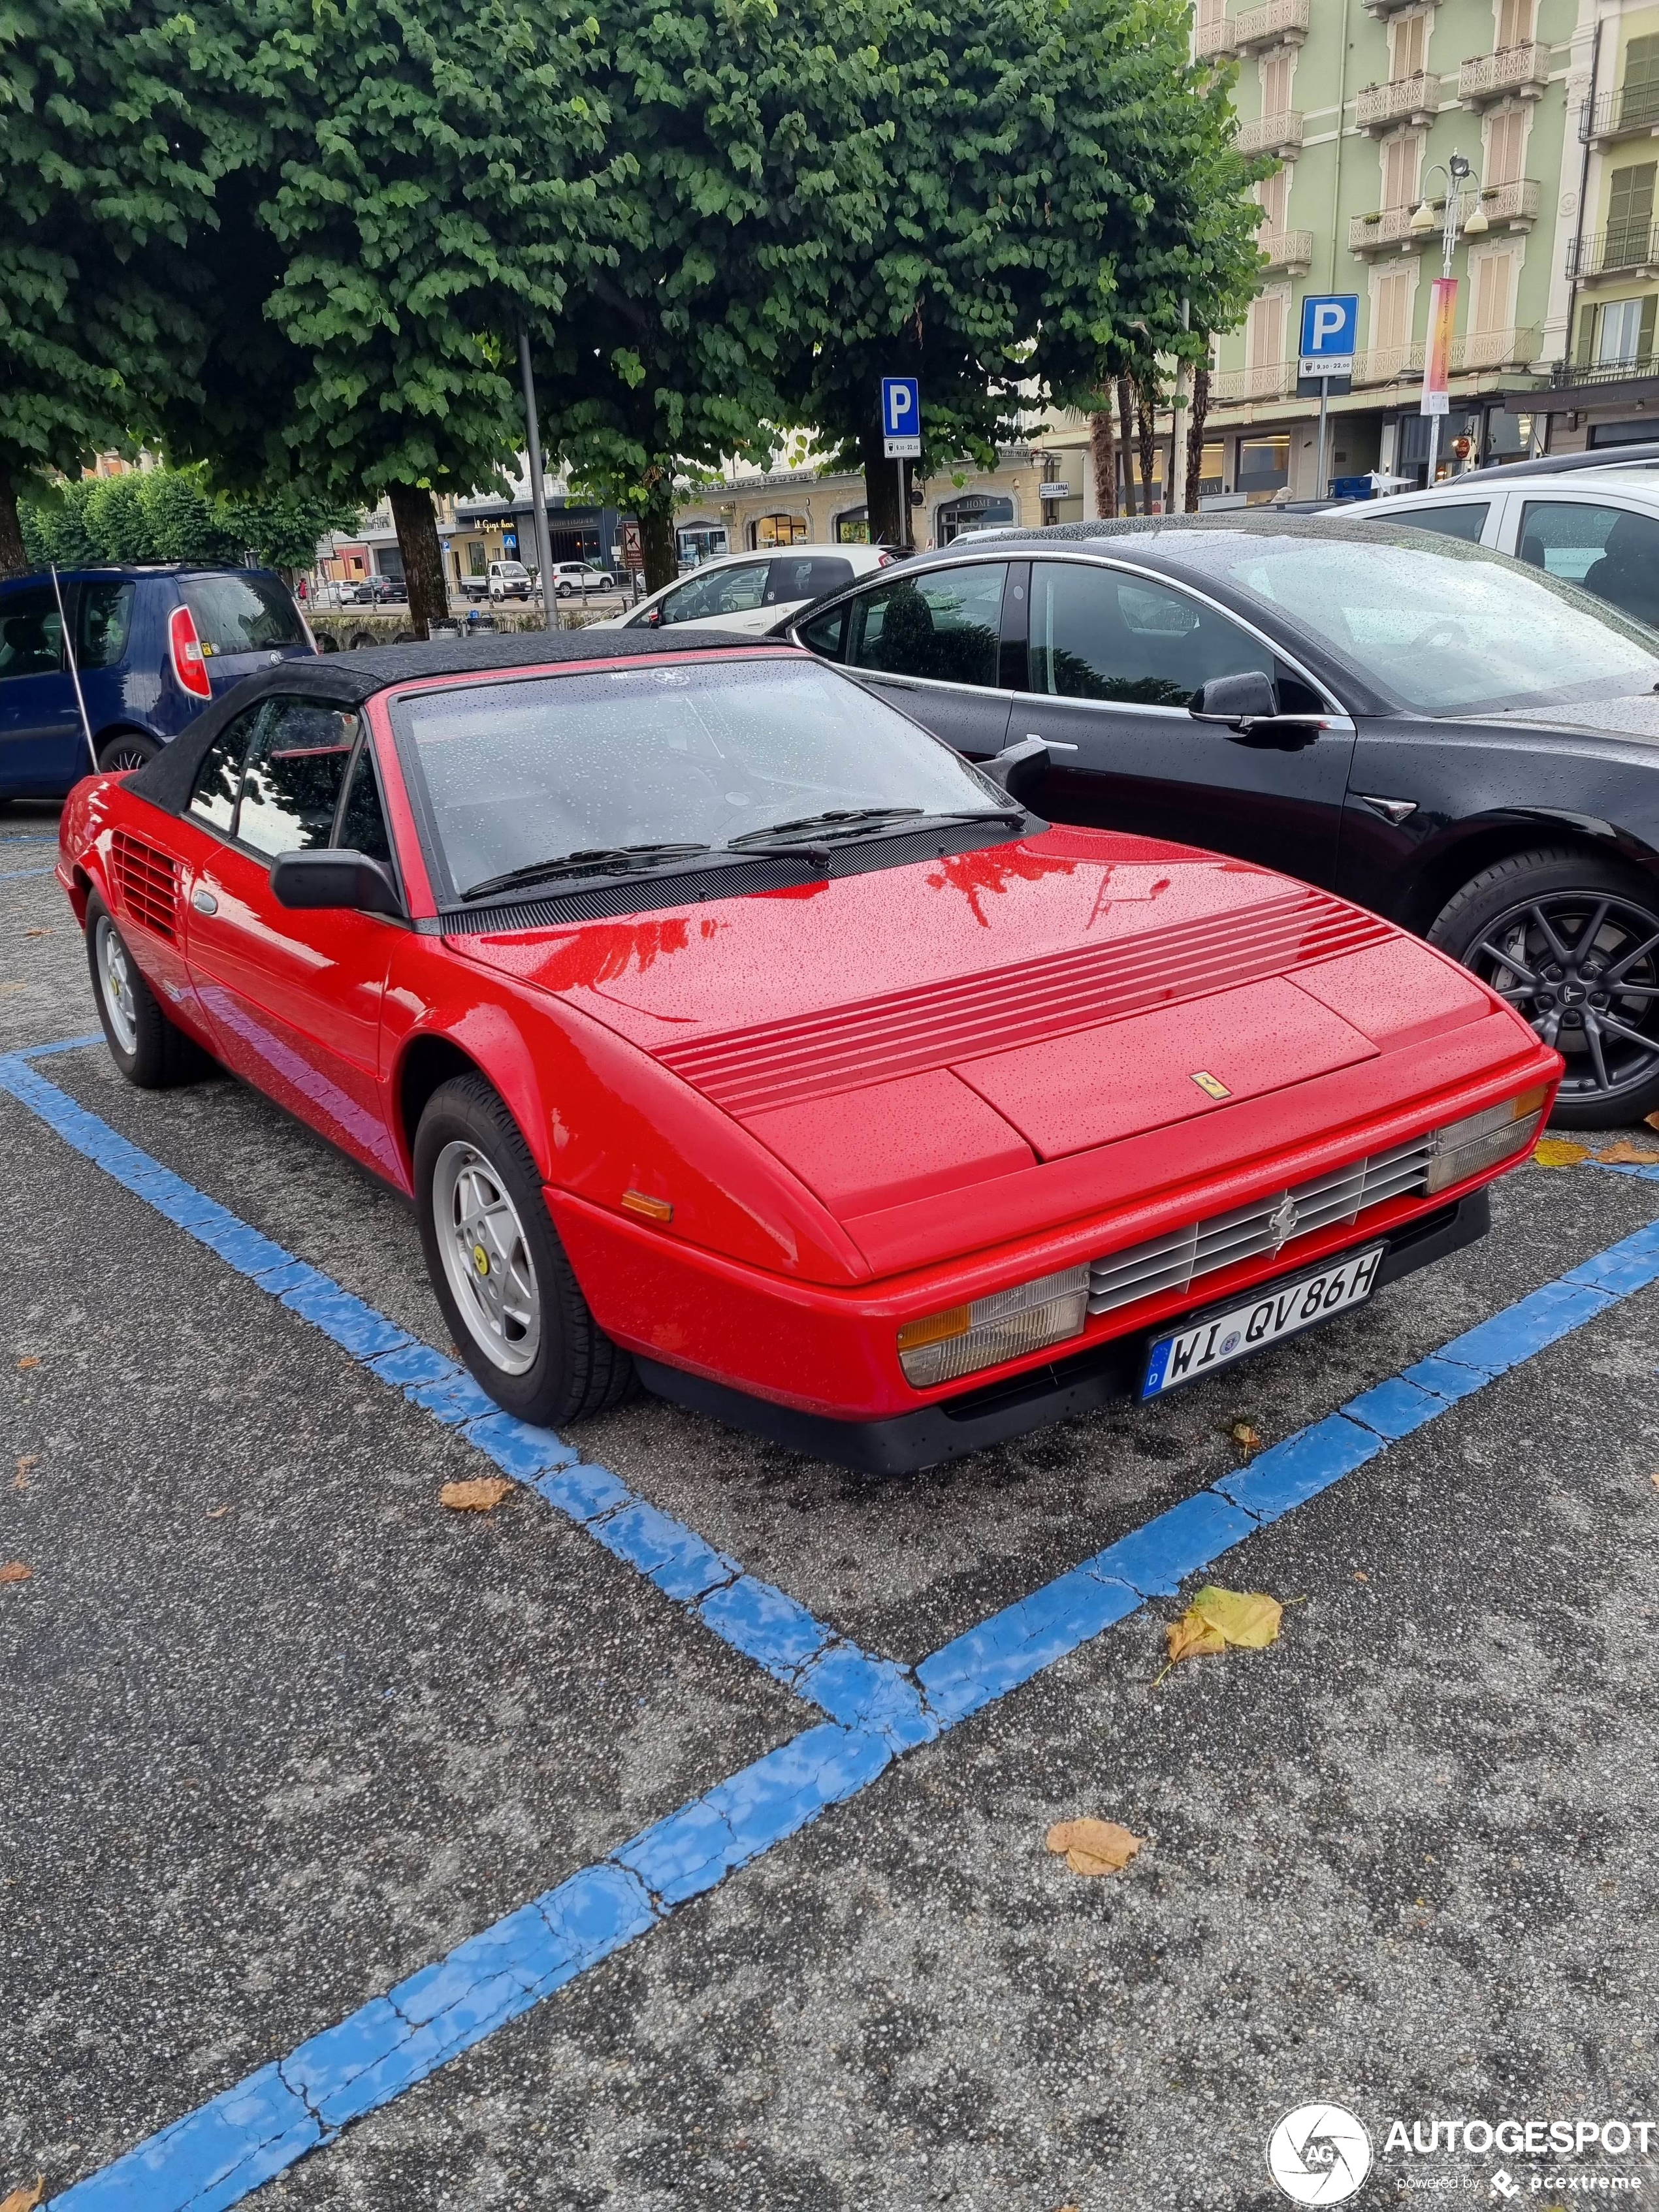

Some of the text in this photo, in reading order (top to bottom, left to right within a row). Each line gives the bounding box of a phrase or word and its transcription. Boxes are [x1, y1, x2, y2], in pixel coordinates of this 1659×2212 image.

[1312, 304, 1346, 349] P
[890, 385, 911, 429] P
[966, 499, 991, 509] HOME
[501, 519, 515, 528] bar
[1171, 1322, 1221, 1379] WI
[1148, 1373, 1158, 1387] D
